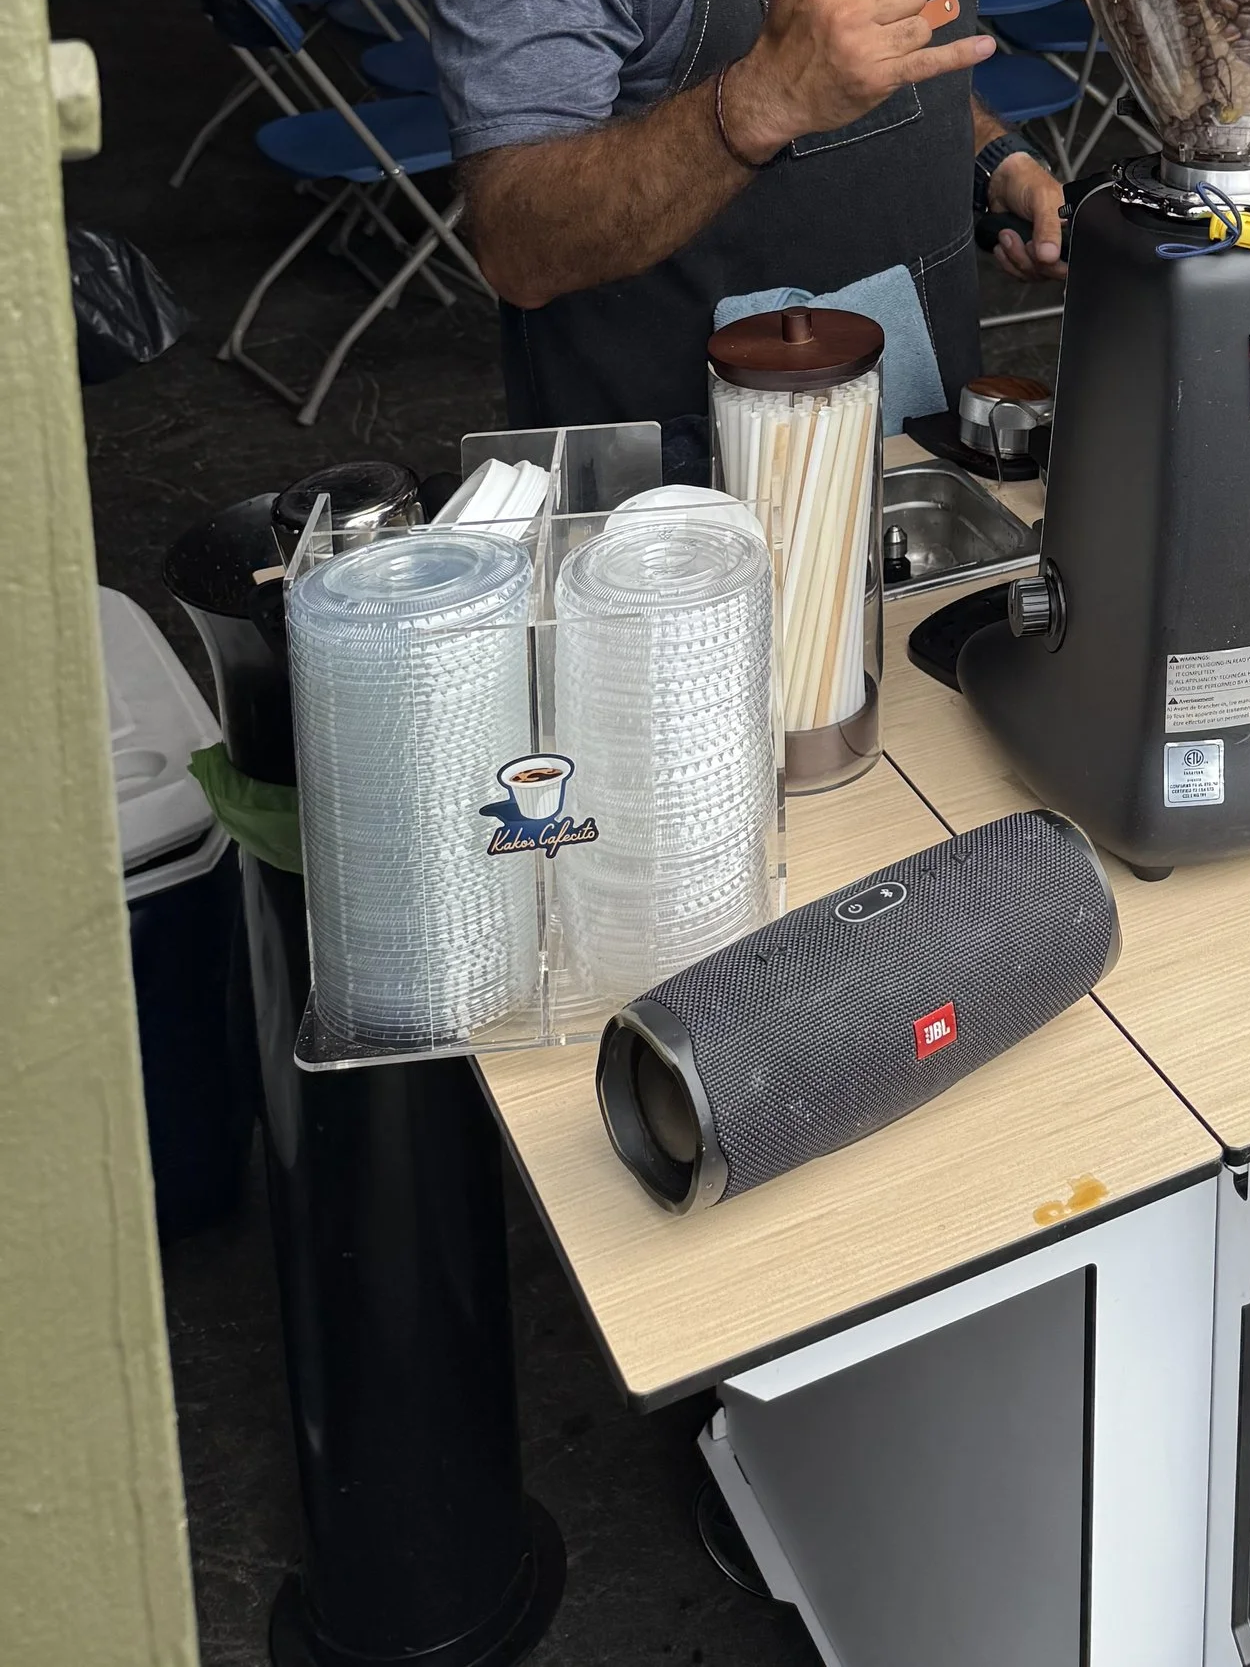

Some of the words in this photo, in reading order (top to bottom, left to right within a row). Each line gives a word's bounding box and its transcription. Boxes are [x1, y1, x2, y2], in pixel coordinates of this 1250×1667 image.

[491, 827, 536, 853] Kako's
[538, 820, 596, 856] Cafecito
[924, 1018, 951, 1045] JBL
